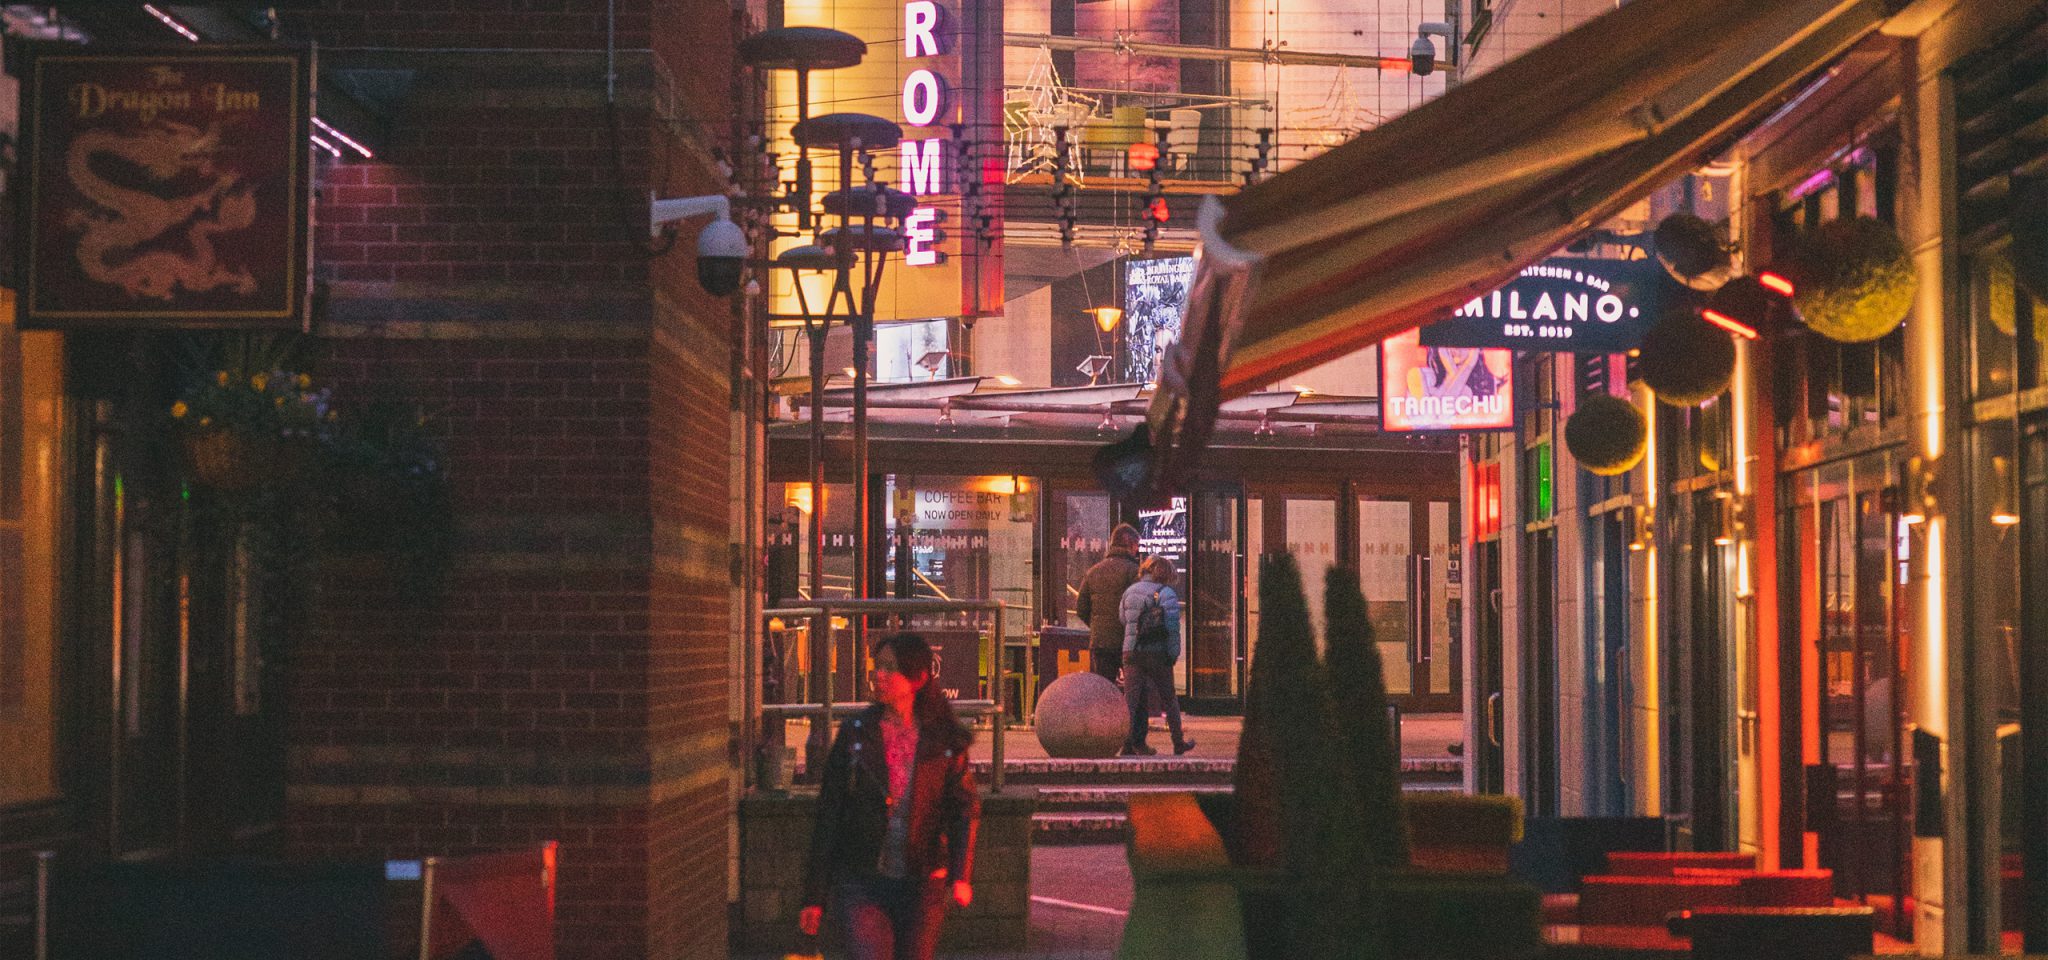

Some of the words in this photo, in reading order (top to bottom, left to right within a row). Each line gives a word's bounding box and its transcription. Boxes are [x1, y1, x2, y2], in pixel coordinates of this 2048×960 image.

[149, 66, 184, 86] The
[69, 82, 190, 121] Dragon
[204, 82, 259, 111] Inn
[1575, 272, 1584, 283] &
[1587, 275, 1610, 292] BAR
[1504, 324, 1534, 337] EST.
[1539, 326, 1573, 338] 2019
[1389, 395, 1503, 417] TAMECHU
[924, 490, 973, 503] COFFEE
[976, 491, 1001, 504] BAR
[924, 510, 946, 520] NOW
[948, 510, 972, 520] OPEN
[975, 510, 1001, 521] DAILY
